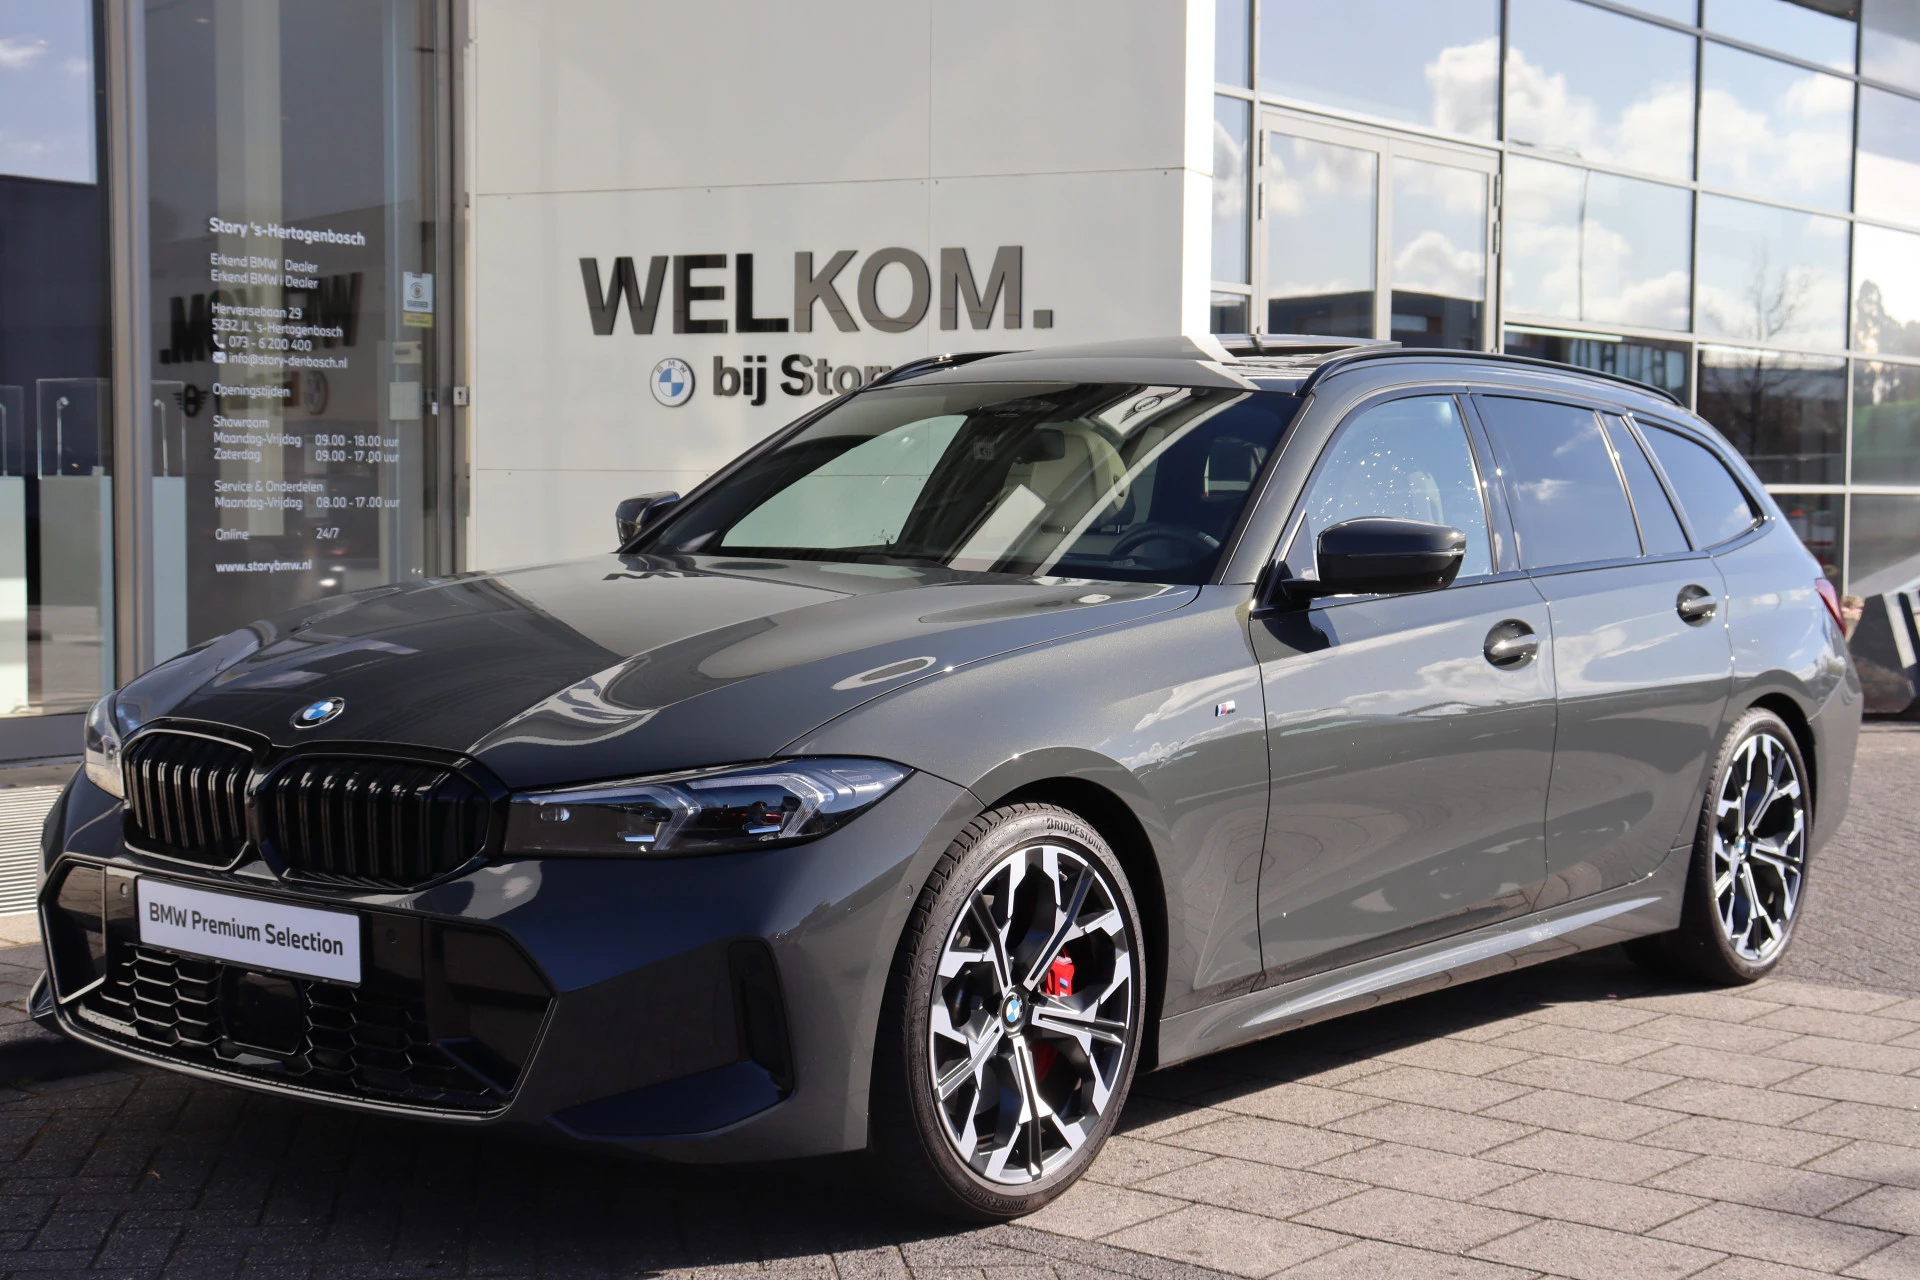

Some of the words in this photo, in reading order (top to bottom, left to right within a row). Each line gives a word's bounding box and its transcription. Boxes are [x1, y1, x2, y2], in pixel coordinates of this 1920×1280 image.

[209, 217, 247, 238] Story
[250, 222, 366, 246] 's-Hertogenbosch
[210, 252, 248, 268] Erkend
[250, 256, 278, 270] BMW
[285, 259, 319, 273] Dealer
[210, 269, 248, 283] Erkend
[250, 272, 278, 285] BMW
[285, 275, 319, 289] Dealer
[578, 245, 1054, 336] WELKOM.
[211, 302, 287, 318] Hervensebaan
[288, 306, 303, 320] 29
[211, 318, 238, 332] 5232
[240, 320, 252, 333] JL
[254, 321, 344, 338] 's-Hertogenbosch
[228, 335, 250, 349] 073
[258, 337, 266, 350] 6
[267, 338, 290, 351] 200
[290, 339, 313, 352] 400
[228, 352, 349, 369] info@story-denbosch.nl
[656, 360, 687, 374] BMW
[712, 355, 768, 407] bij
[780, 354, 892, 397] Stor
[212, 383, 291, 399] Openingstijden
[212, 415, 270, 429] Showroom
[213, 431, 303, 448] Maandag-Vrijdag
[315, 434, 346, 447] 09.00
[353, 435, 382, 448] 18.00
[382, 438, 400, 448] uur
[213, 448, 262, 462] Zaterdag
[315, 449, 346, 462] 09.00
[383, 452, 400, 463] uur
[214, 480, 253, 493] Service
[255, 481, 264, 493] &
[265, 480, 324, 493] Onderdelen
[214, 496, 304, 511] Maandag-Vrijdag
[315, 496, 347, 509] 08.00
[383, 498, 401, 509] uur
[214, 528, 249, 541] Online
[315, 527, 341, 540] 24/7
[215, 559, 313, 574] www.storybmw.nl
[1046, 818, 1104, 854] BRIDGESTONE
[149, 902, 187, 928] BMW
[191, 910, 261, 942] Premium
[265, 923, 343, 956] Selection
